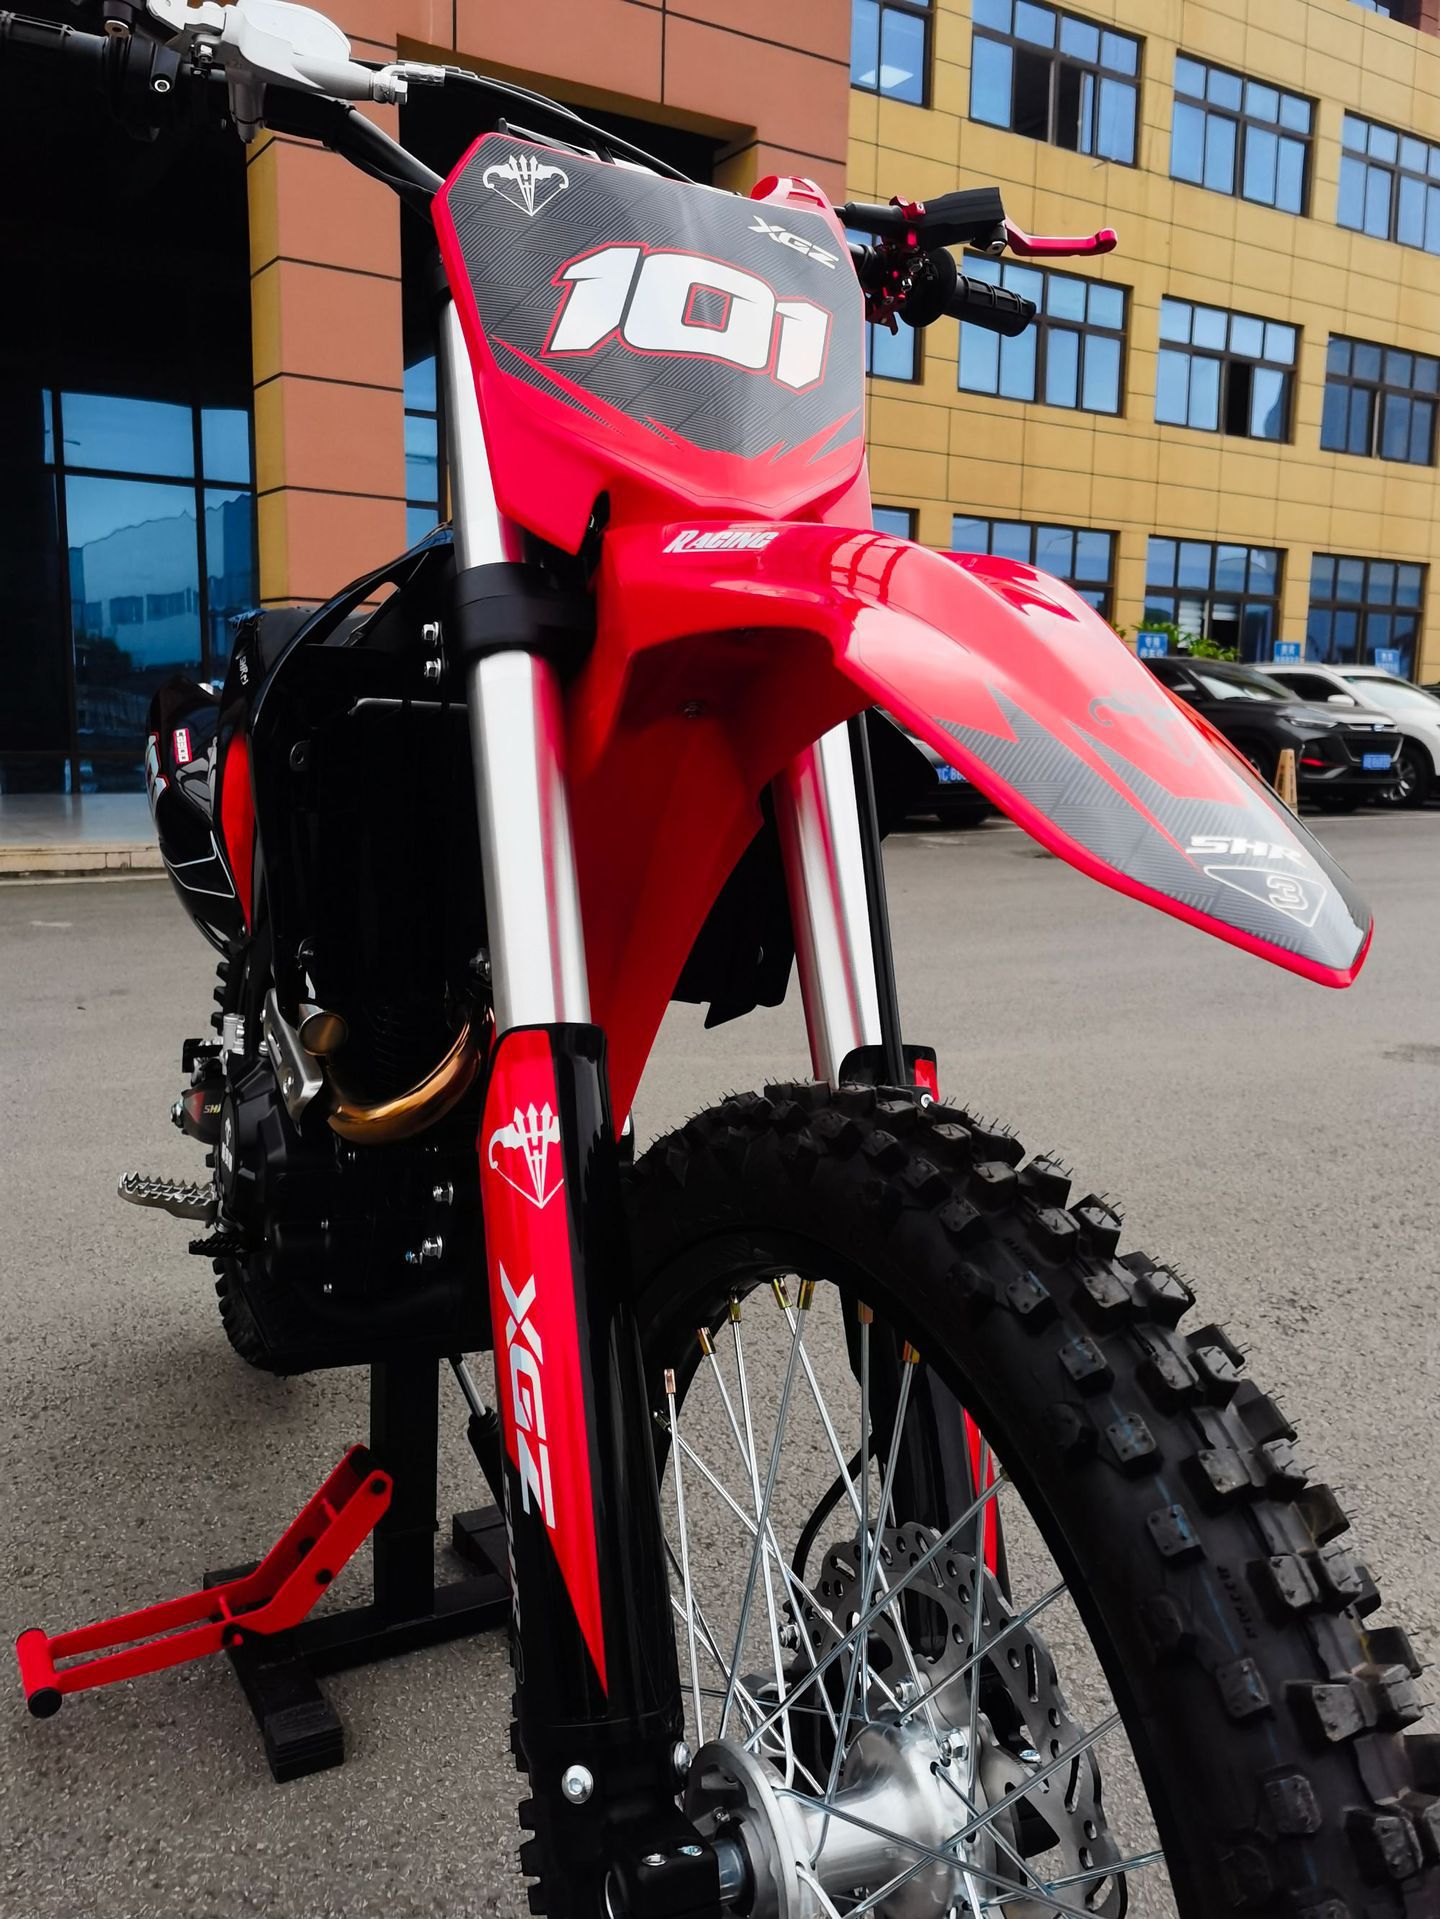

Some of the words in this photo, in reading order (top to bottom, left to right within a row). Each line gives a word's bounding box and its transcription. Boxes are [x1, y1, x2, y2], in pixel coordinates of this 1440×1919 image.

[747, 215, 839, 269] XGZ
[542, 244, 832, 393] 101
[662, 530, 779, 553] RACING
[1185, 836, 1307, 868] SHR
[500, 1260, 556, 1529] XGZ
